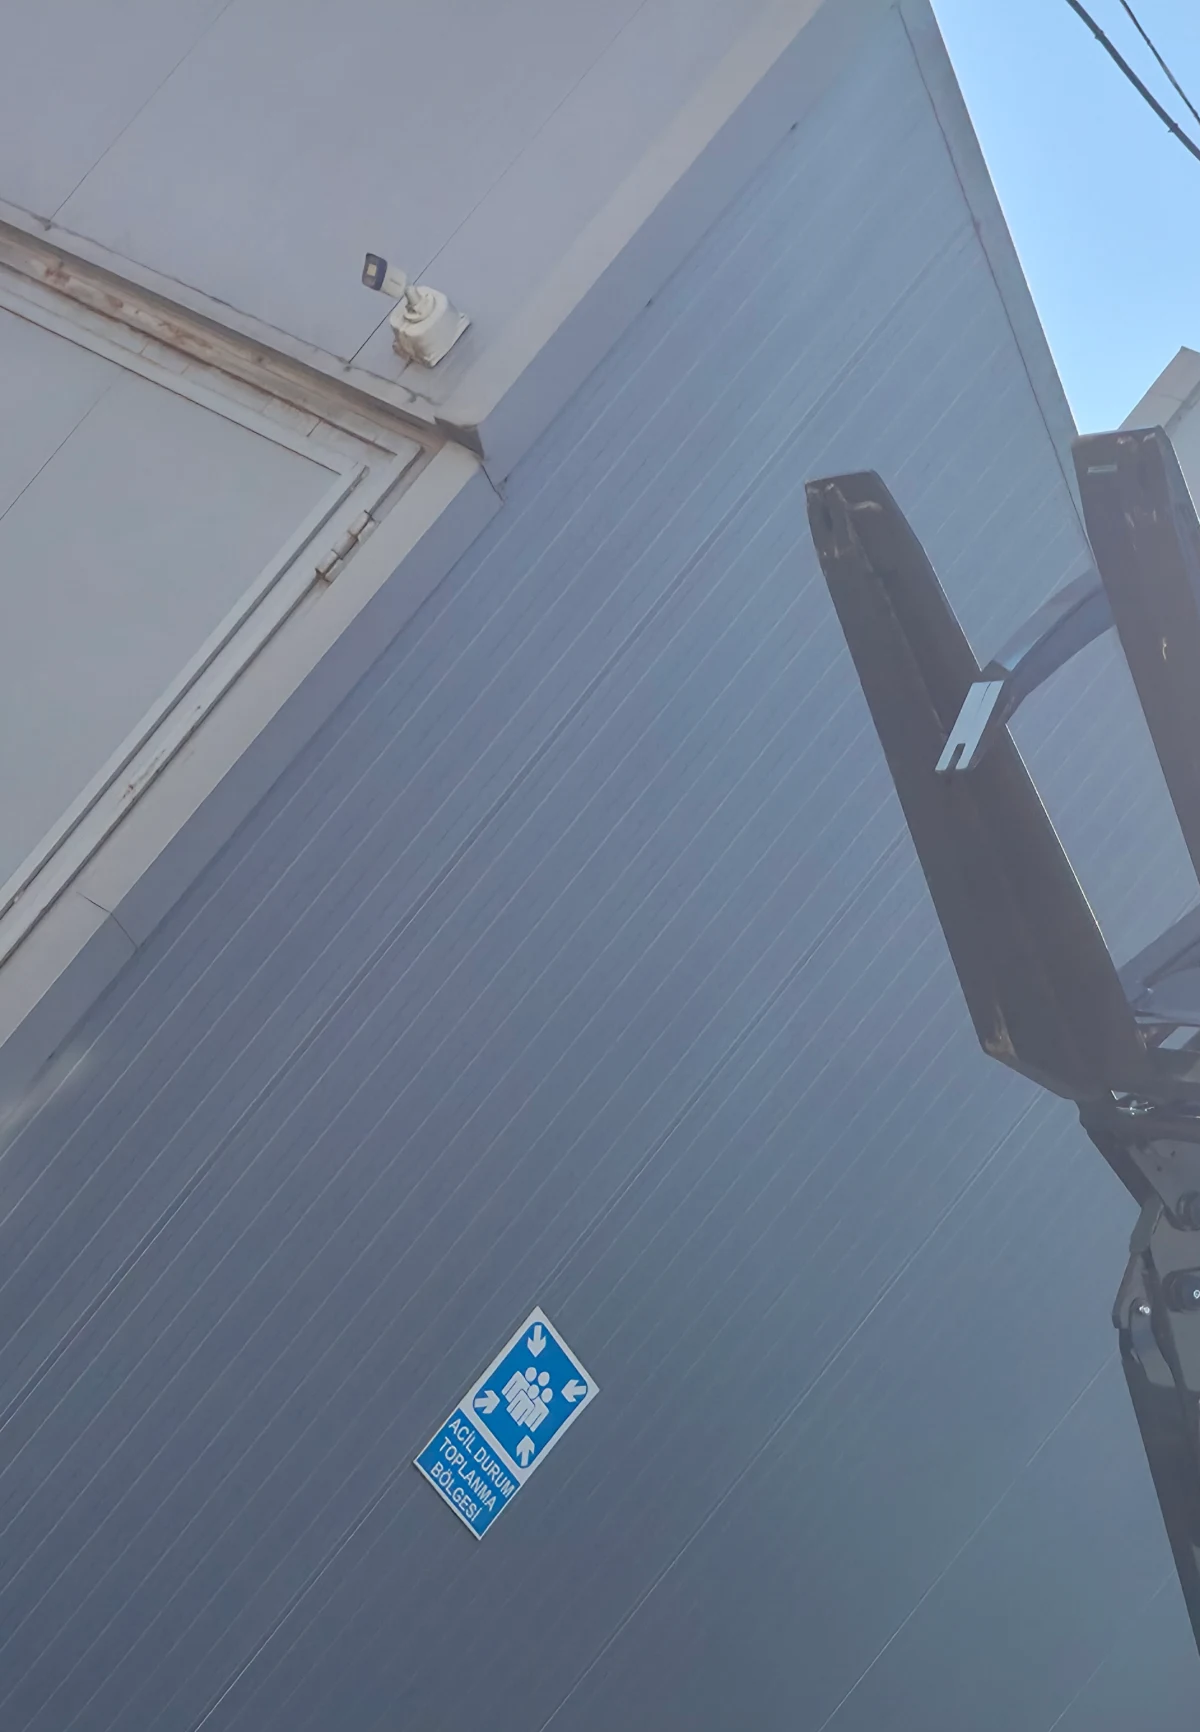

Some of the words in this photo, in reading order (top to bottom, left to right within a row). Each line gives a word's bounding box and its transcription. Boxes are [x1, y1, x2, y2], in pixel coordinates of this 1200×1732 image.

[430, 1461, 483, 1522] BÖLGESİ
[439, 1436, 497, 1511] TOPLANMA
[448, 1418, 476, 1454] ACİL
[473, 1446, 515, 1498] DURUM
